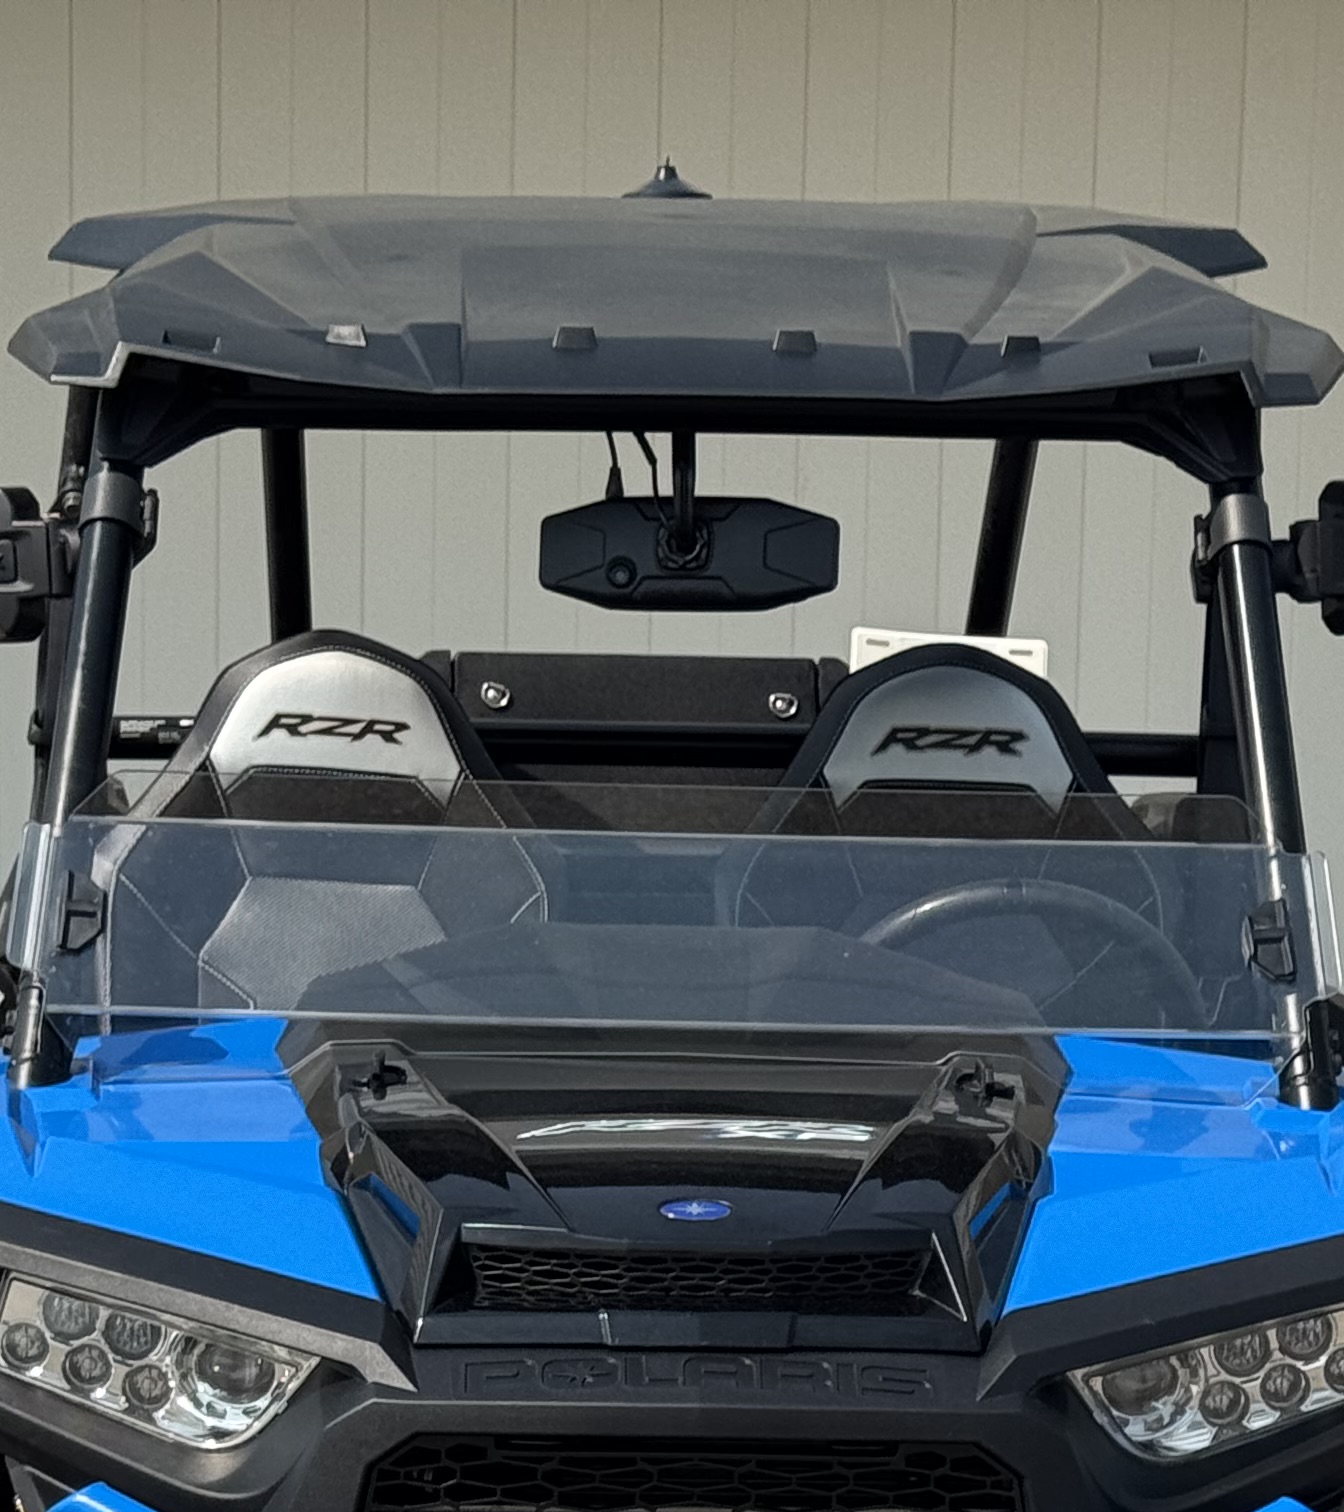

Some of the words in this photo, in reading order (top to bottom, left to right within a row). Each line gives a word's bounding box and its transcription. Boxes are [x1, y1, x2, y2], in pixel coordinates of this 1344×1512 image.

[253, 713, 411, 744] RZR
[870, 727, 1030, 757] RZR
[462, 1354, 935, 1397] POLARIS
